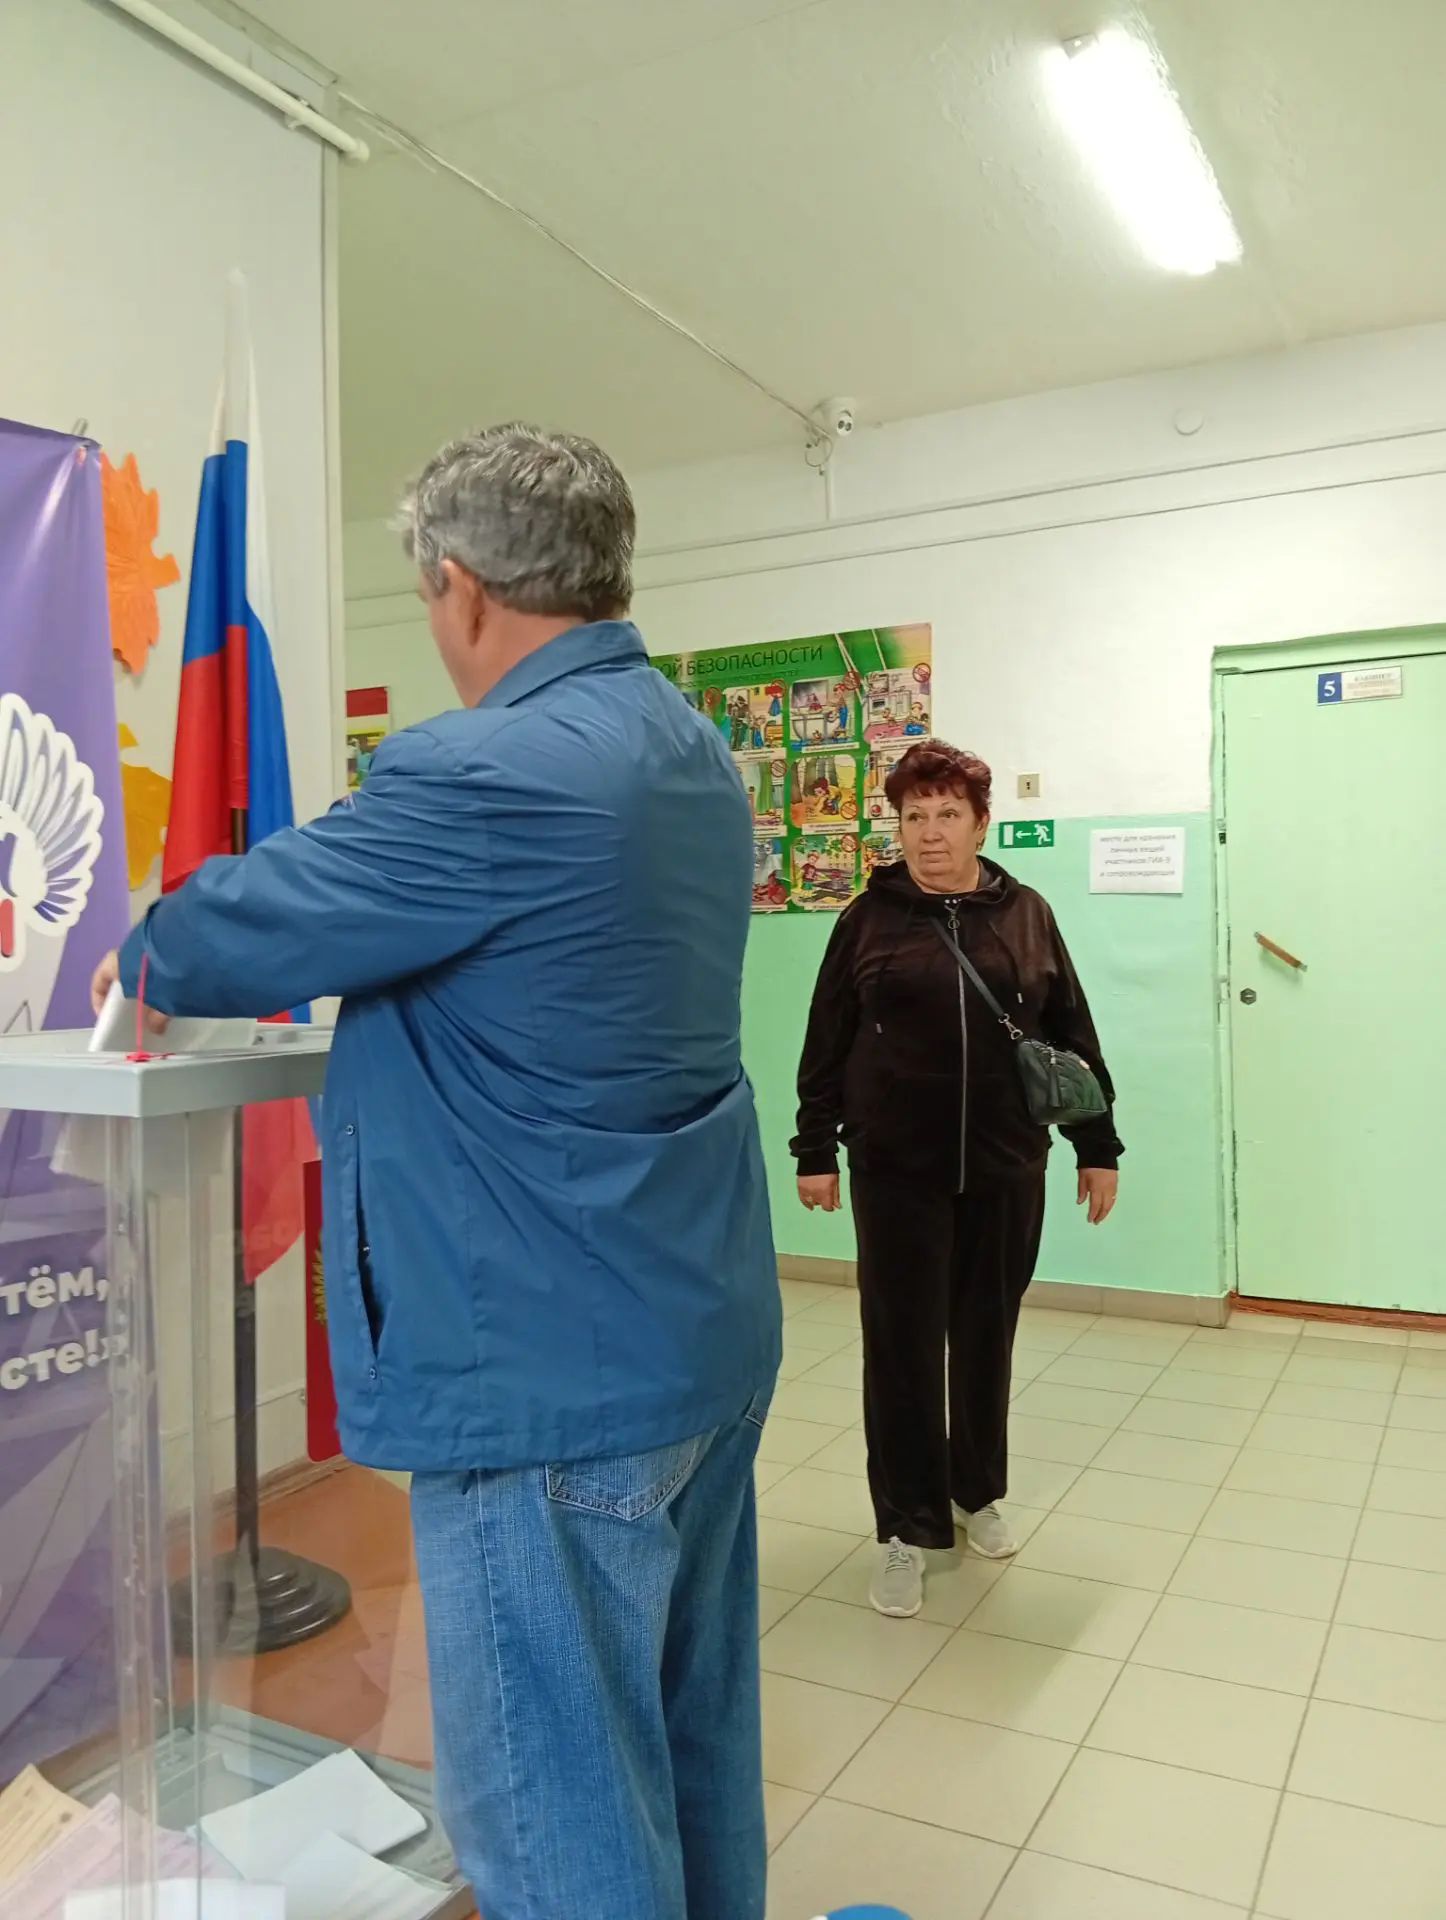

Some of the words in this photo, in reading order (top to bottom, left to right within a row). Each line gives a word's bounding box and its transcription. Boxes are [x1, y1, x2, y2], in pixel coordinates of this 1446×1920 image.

[658, 657, 682, 678] ОЙ
[686, 645, 823, 676] БЕЗОПАСНОСТИ
[1323, 680, 1336, 697] 5
